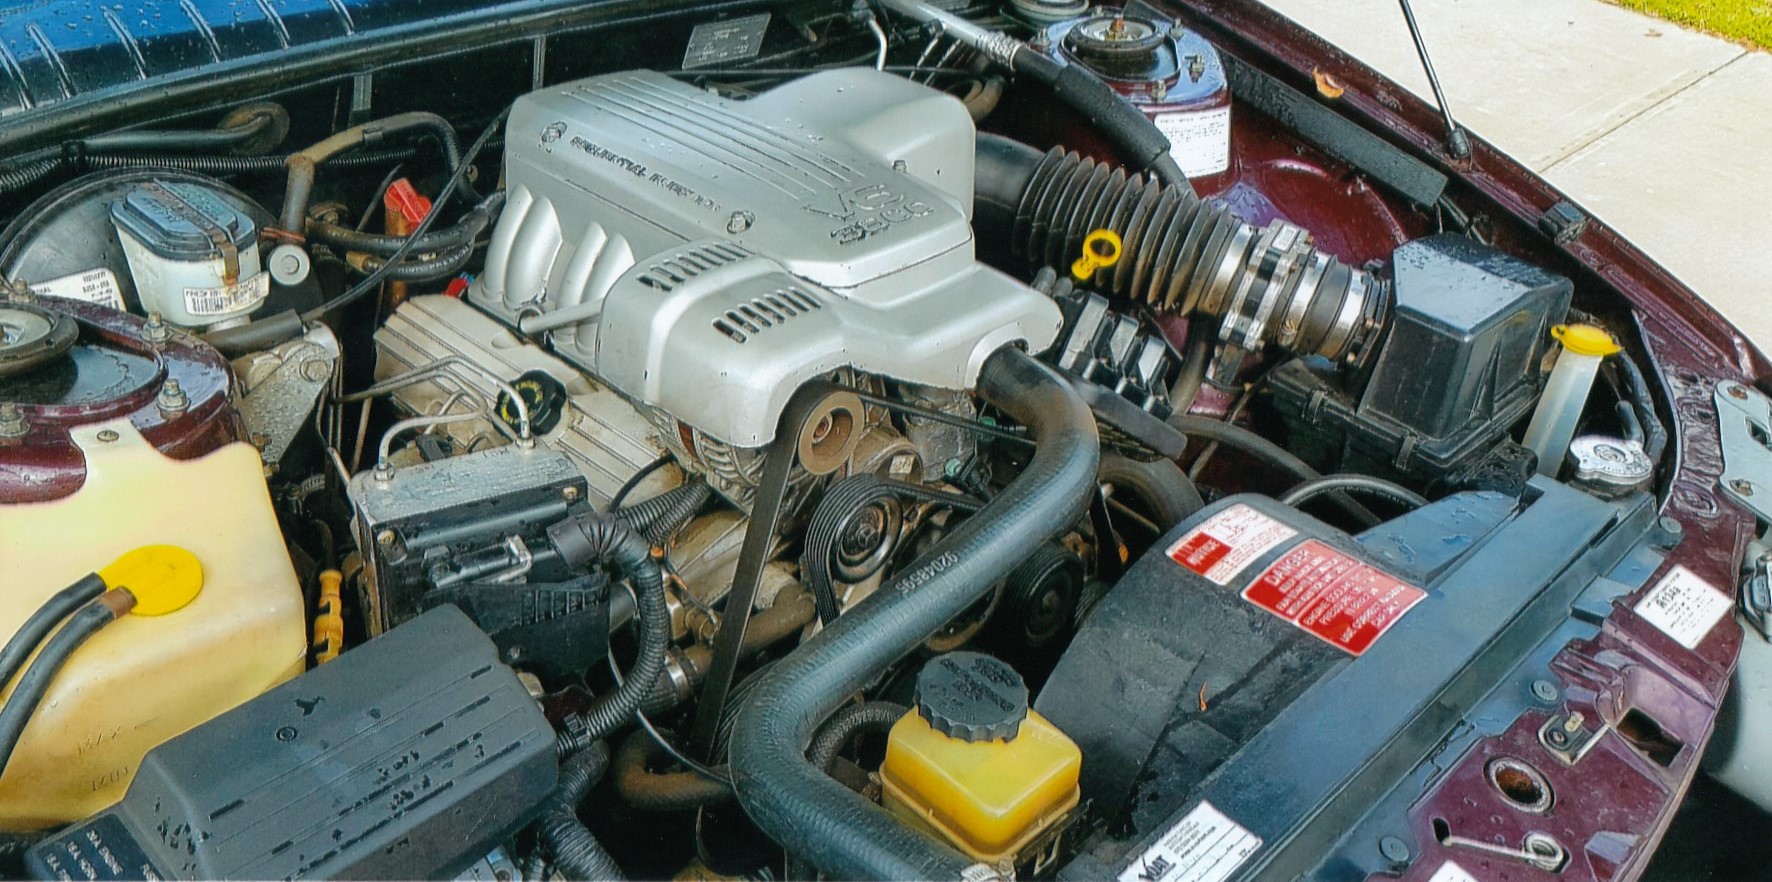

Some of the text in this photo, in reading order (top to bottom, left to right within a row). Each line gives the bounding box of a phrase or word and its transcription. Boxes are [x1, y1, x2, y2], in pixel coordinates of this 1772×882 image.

[1187, 541, 1221, 566] NOTICE
[1263, 549, 1311, 586] DANGER
[895, 551, 960, 594] 92048595
[78, 724, 121, 754] MAX
